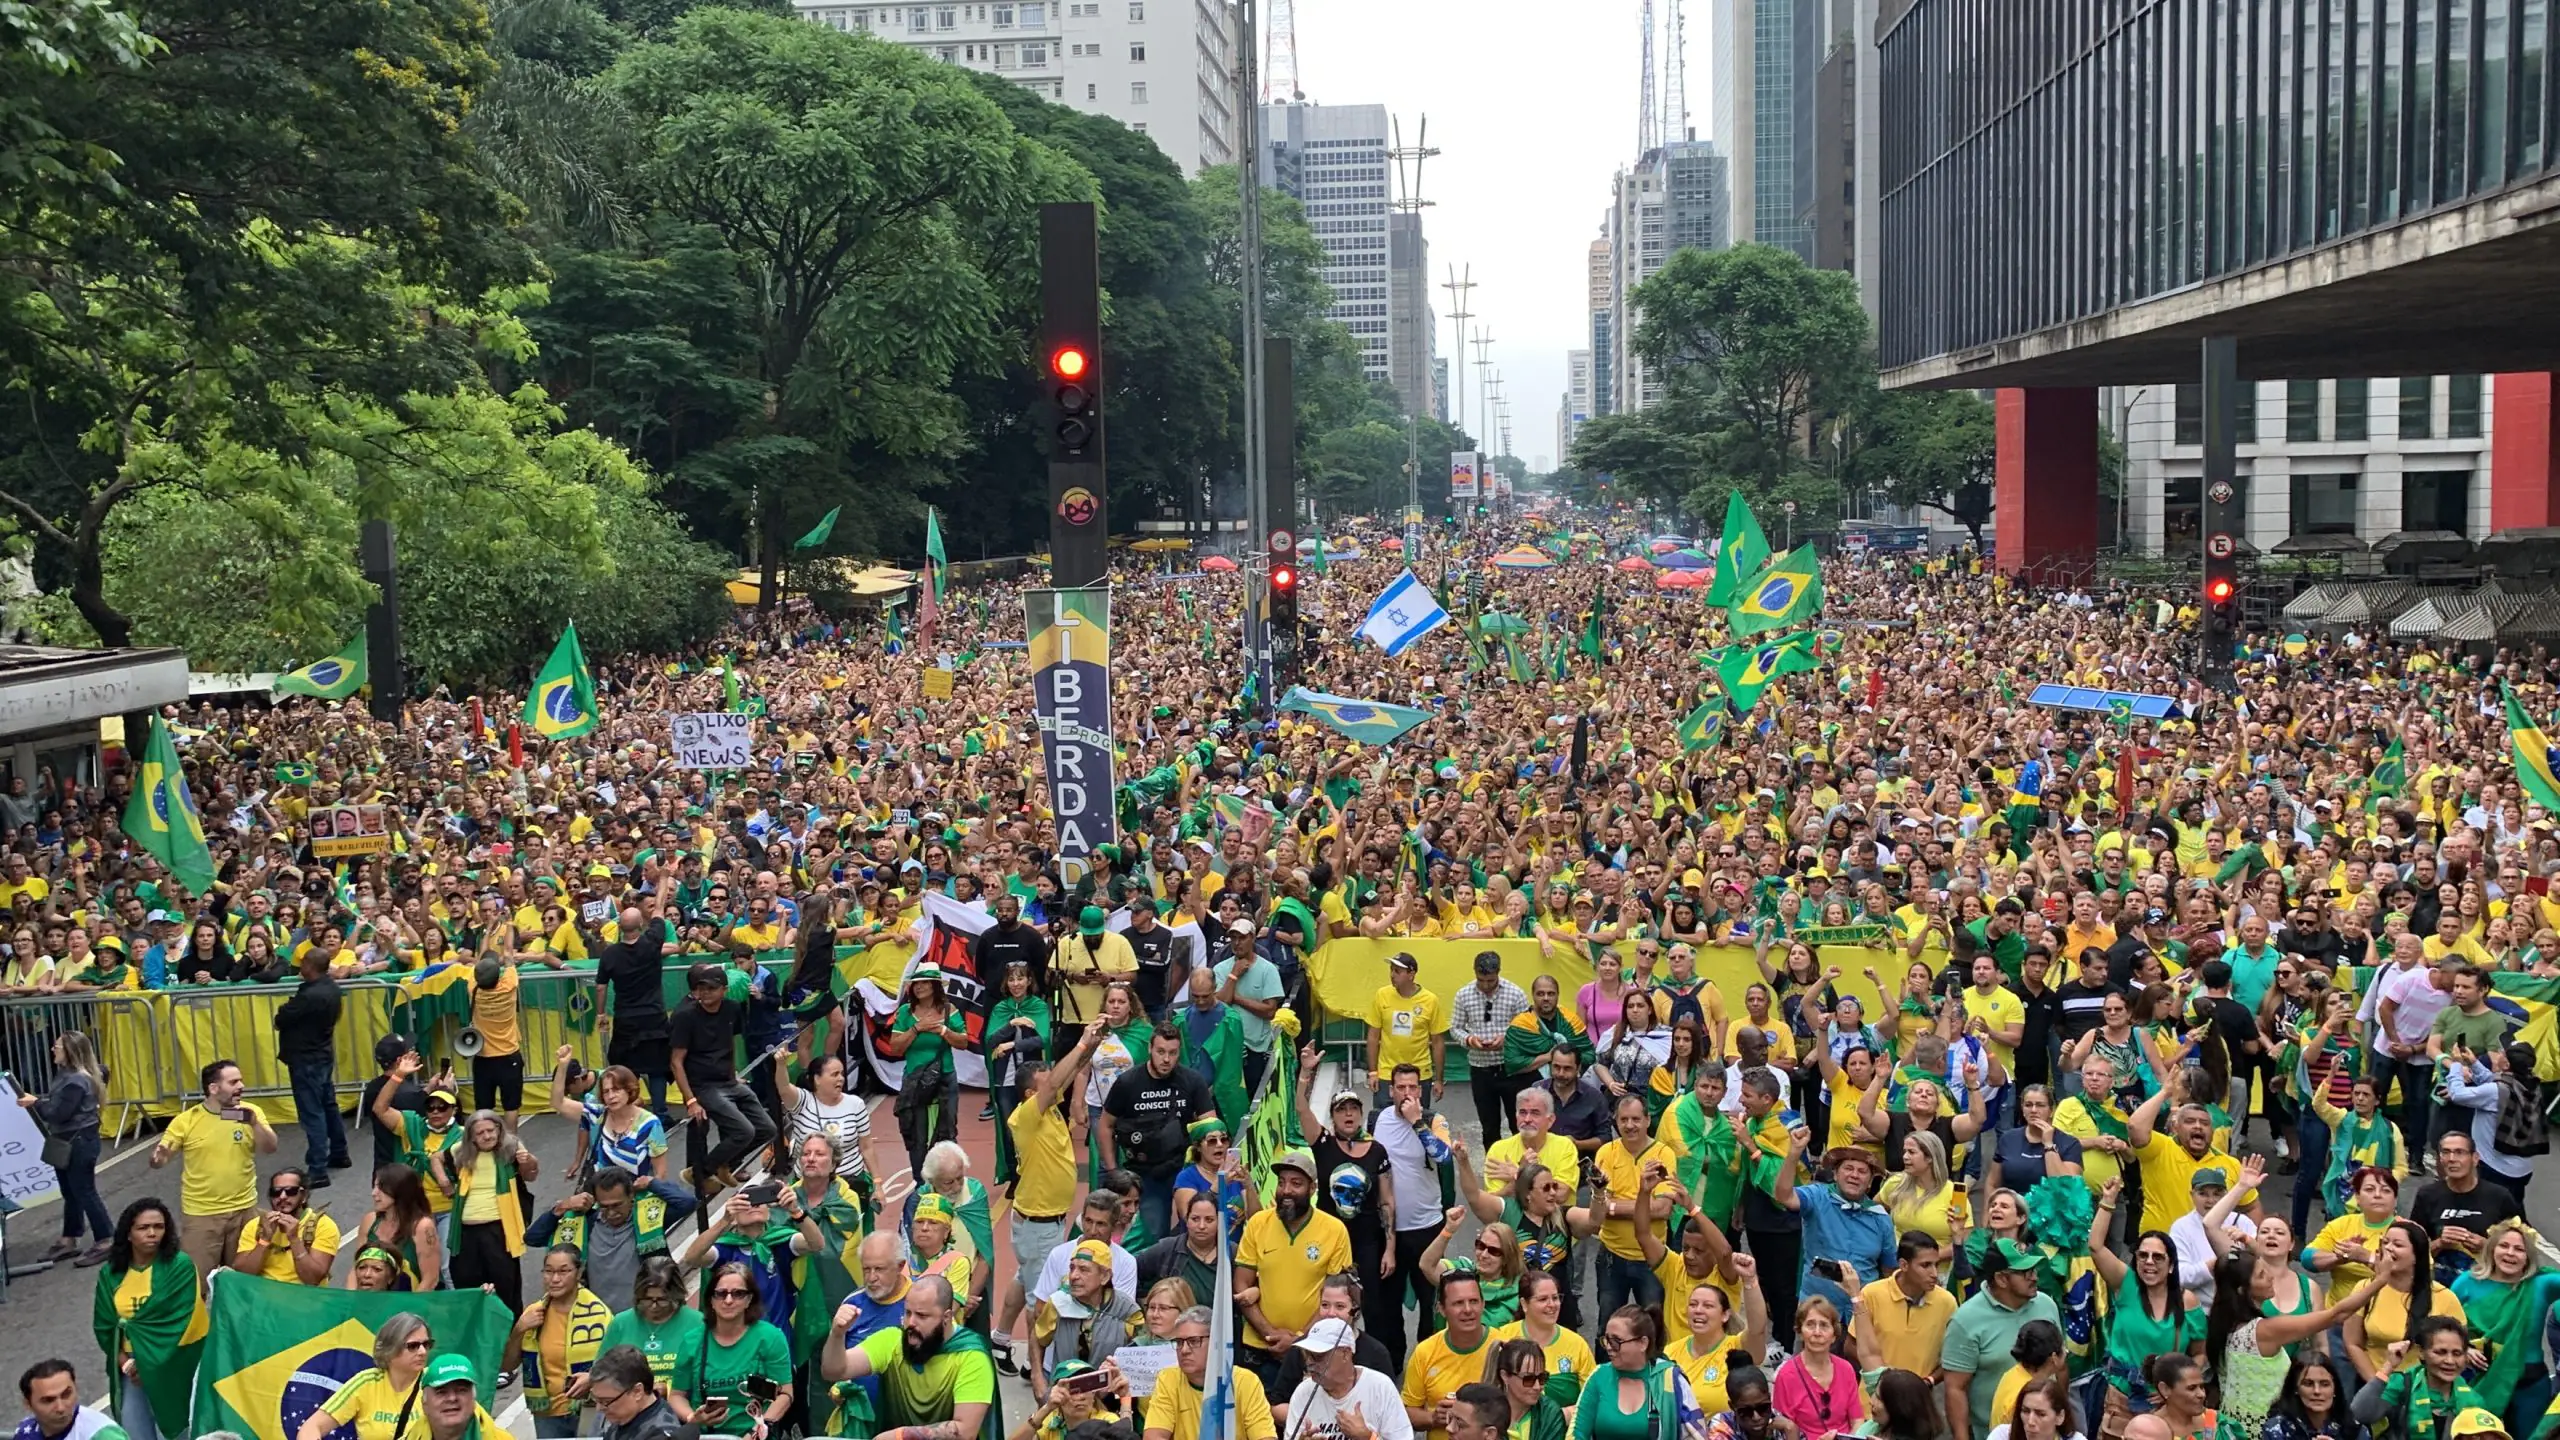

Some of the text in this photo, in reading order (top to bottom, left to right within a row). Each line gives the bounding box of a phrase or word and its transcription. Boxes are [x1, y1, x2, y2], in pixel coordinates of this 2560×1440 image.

[2215, 539, 2227, 553] E
[705, 714, 747, 728] LIXO
[683, 746, 746, 765] NEWS
[1806, 928, 1869, 941] BRASIL
[1141, 1088, 1179, 1099] CIDAD
[1133, 1099, 1187, 1111] CONSCIETE
